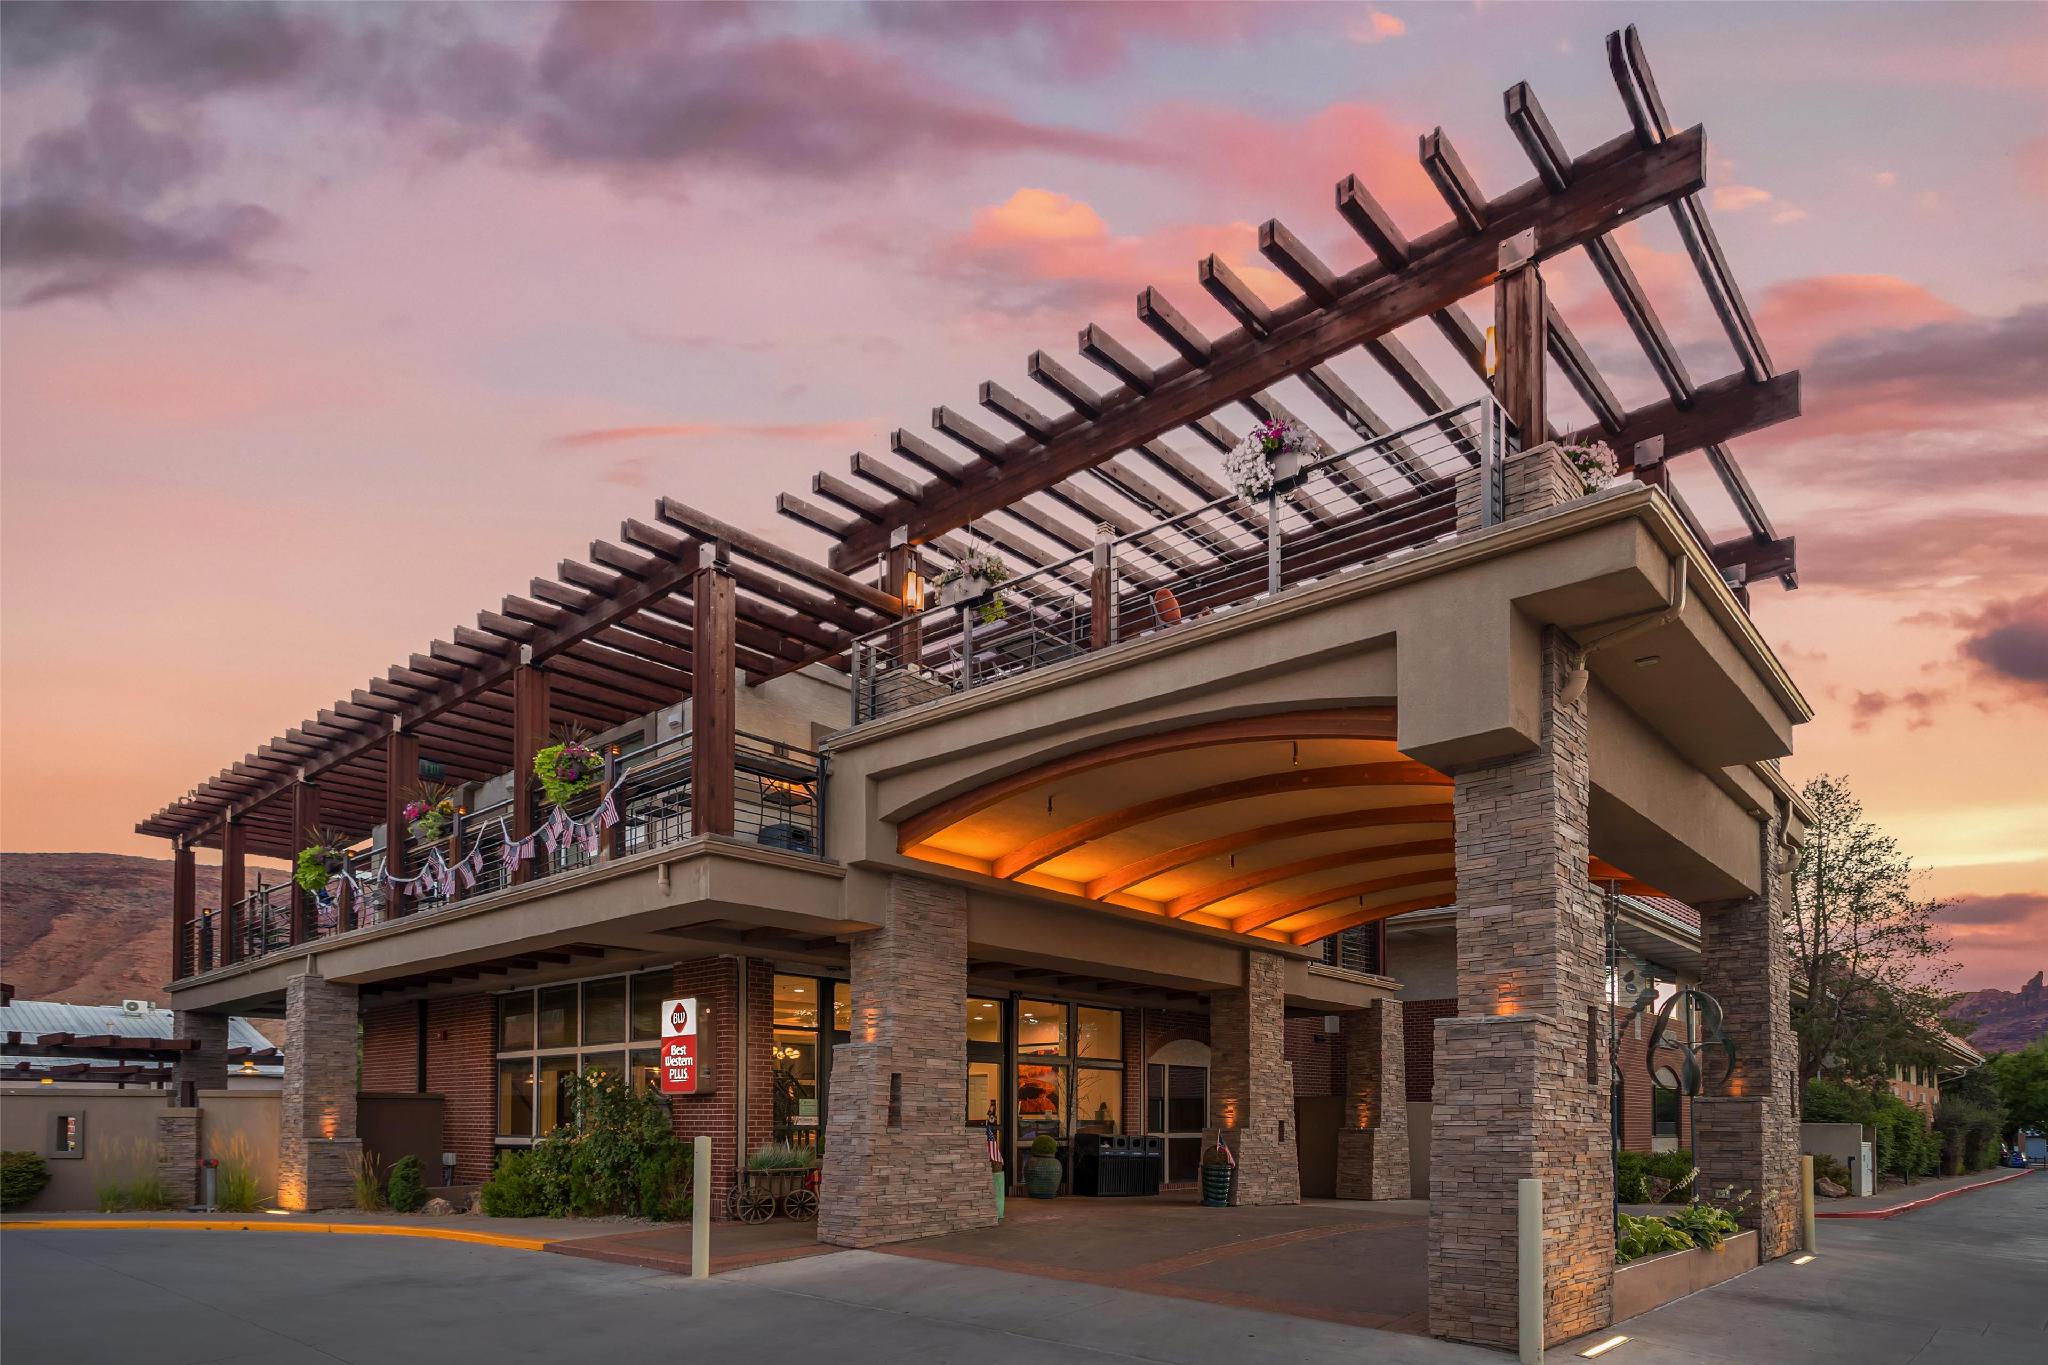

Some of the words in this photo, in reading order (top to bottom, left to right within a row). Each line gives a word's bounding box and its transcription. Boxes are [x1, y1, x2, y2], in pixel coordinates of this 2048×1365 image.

[671, 1045, 687, 1056] Best
[665, 1056, 693, 1067] Western
[669, 1068, 688, 1079] PLUS
